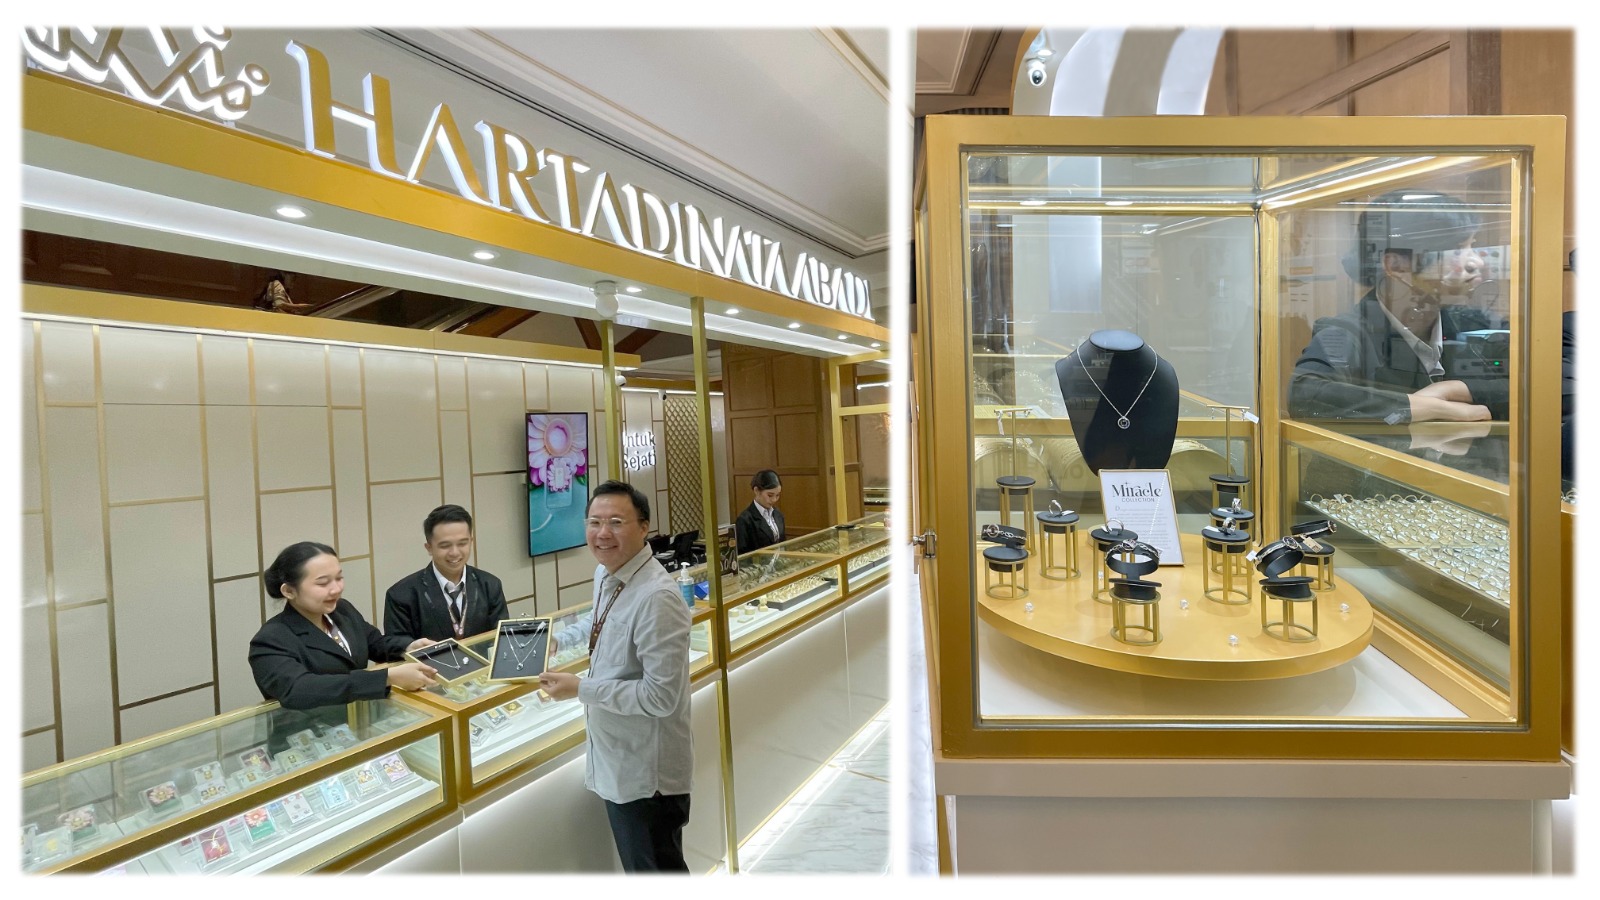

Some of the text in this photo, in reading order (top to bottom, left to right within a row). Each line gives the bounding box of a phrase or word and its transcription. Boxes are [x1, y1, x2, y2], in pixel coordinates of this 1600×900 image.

[286, 39, 875, 321] HARTADINATA ABADI
[1111, 481, 1161, 498] Miracle
